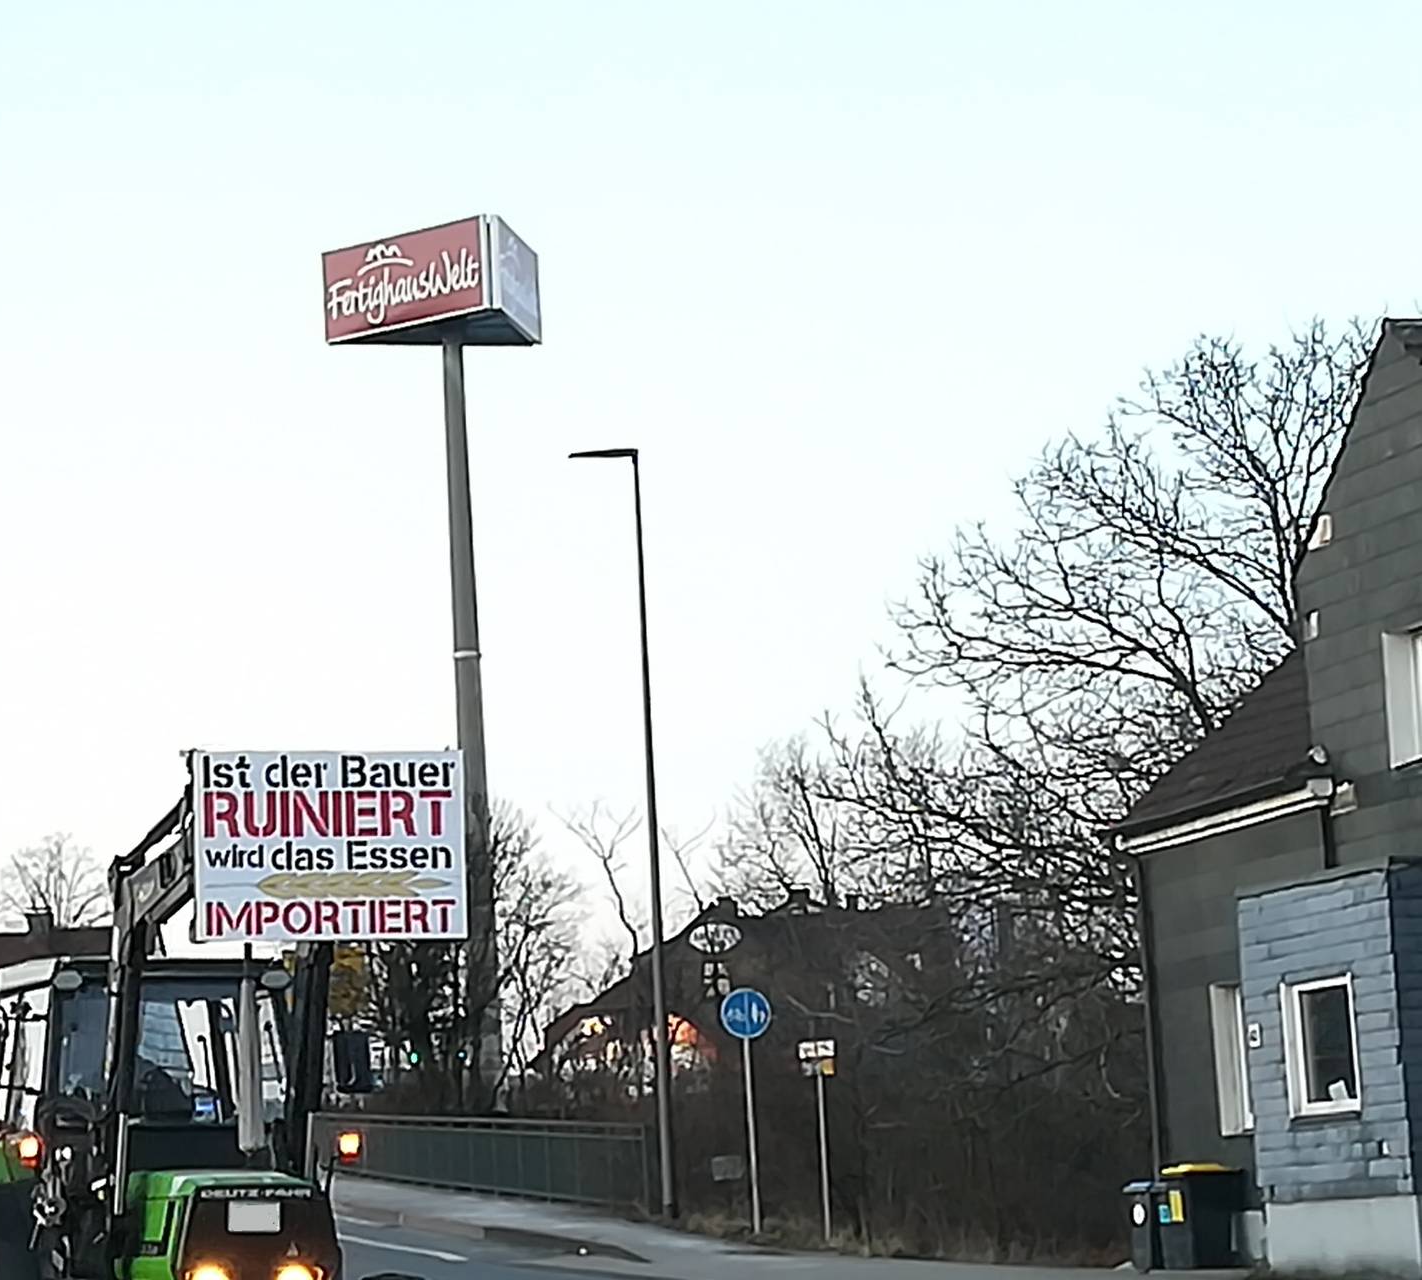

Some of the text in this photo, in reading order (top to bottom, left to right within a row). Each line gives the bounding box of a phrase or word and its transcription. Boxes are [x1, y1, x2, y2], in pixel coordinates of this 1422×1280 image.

[328, 247, 479, 324] FertighausWelt
[203, 755, 455, 788] Ist der Bauer
[204, 790, 452, 837] RUINIERT
[205, 840, 452, 870] wird das Essen
[205, 899, 456, 936] IMPORTIERT
